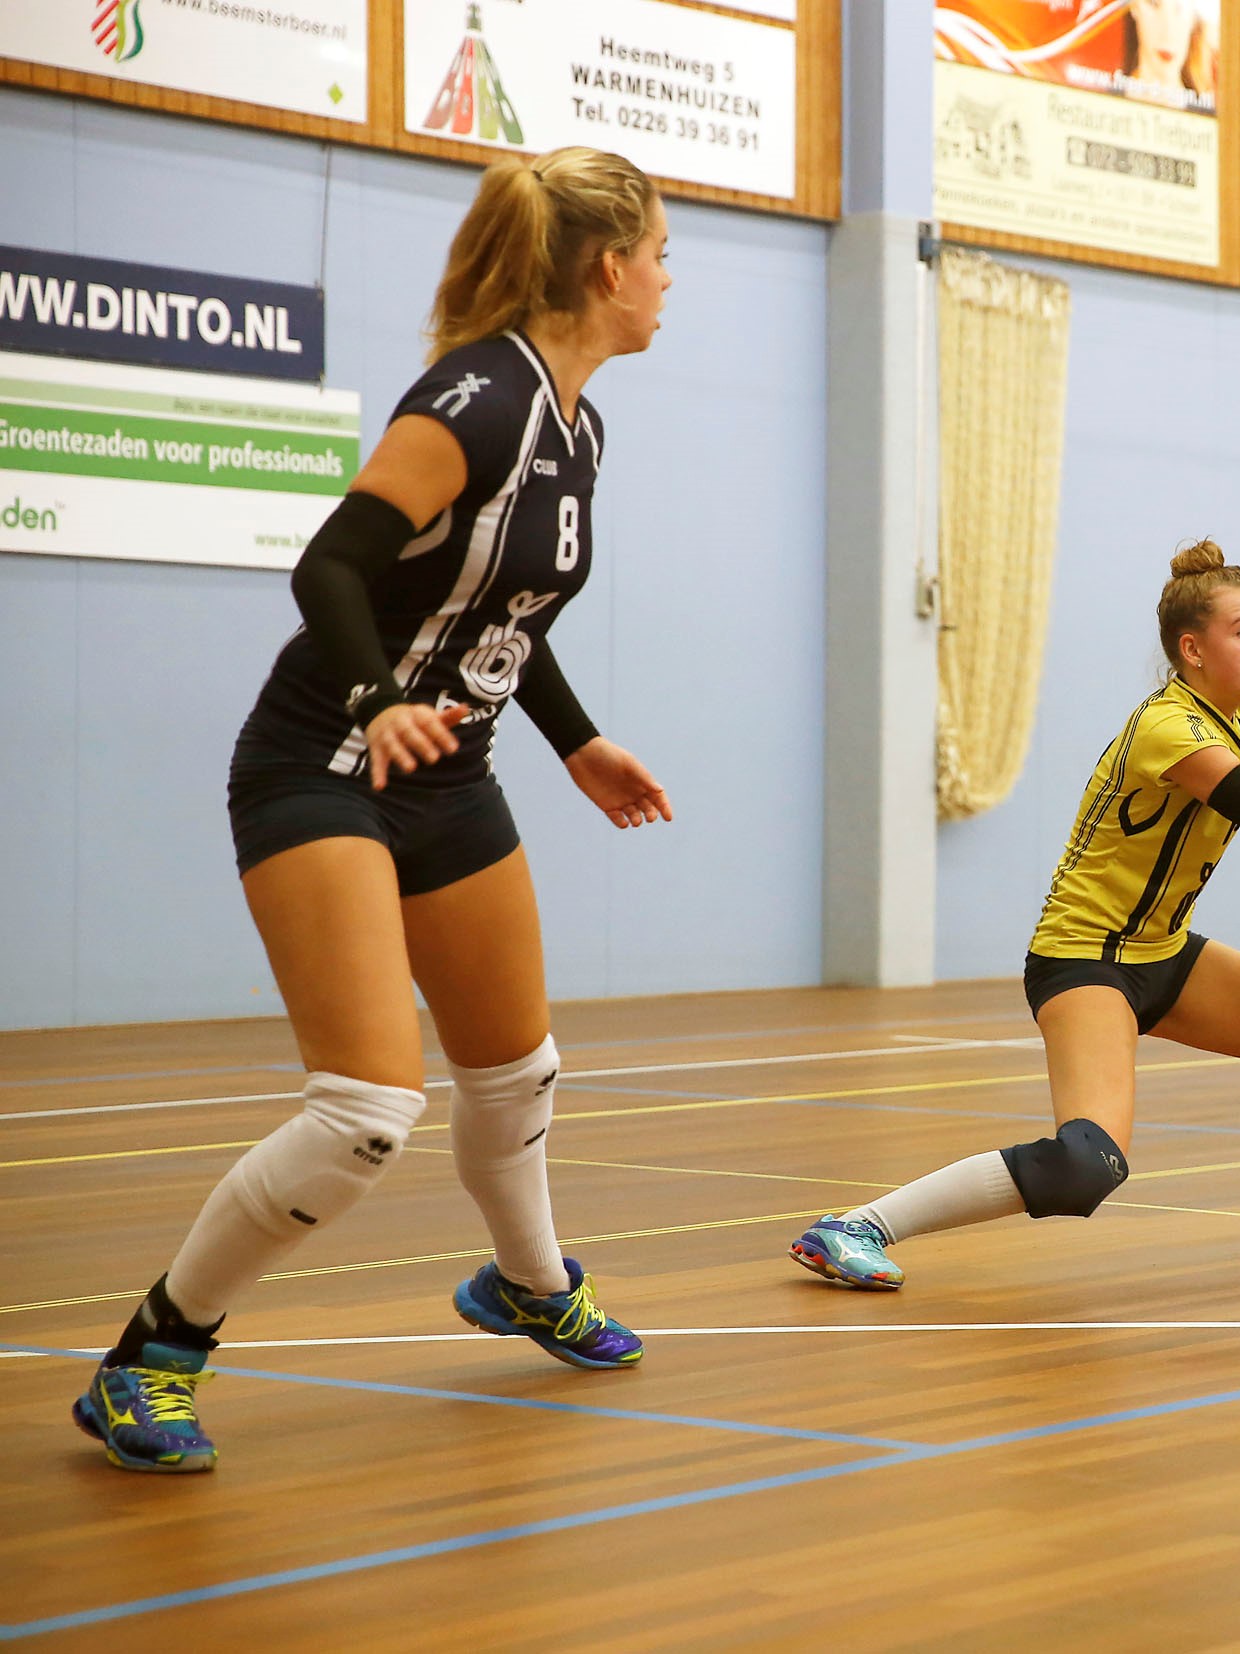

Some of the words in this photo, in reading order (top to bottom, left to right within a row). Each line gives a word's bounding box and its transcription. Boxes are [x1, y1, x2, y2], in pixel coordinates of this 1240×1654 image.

[600, 35, 714, 82] Heemtweg
[723, 61, 735, 81] 5
[571, 63, 761, 118] WARMENHUIZEN
[572, 97, 609, 123] Tel.
[618, 105, 668, 134] 0226
[154, 439, 204, 465] voor
[208, 440, 344, 478] professionals
[532, 458, 559, 476] CLUB
[0, 496, 57, 531] den
[555, 495, 580, 572] 8
